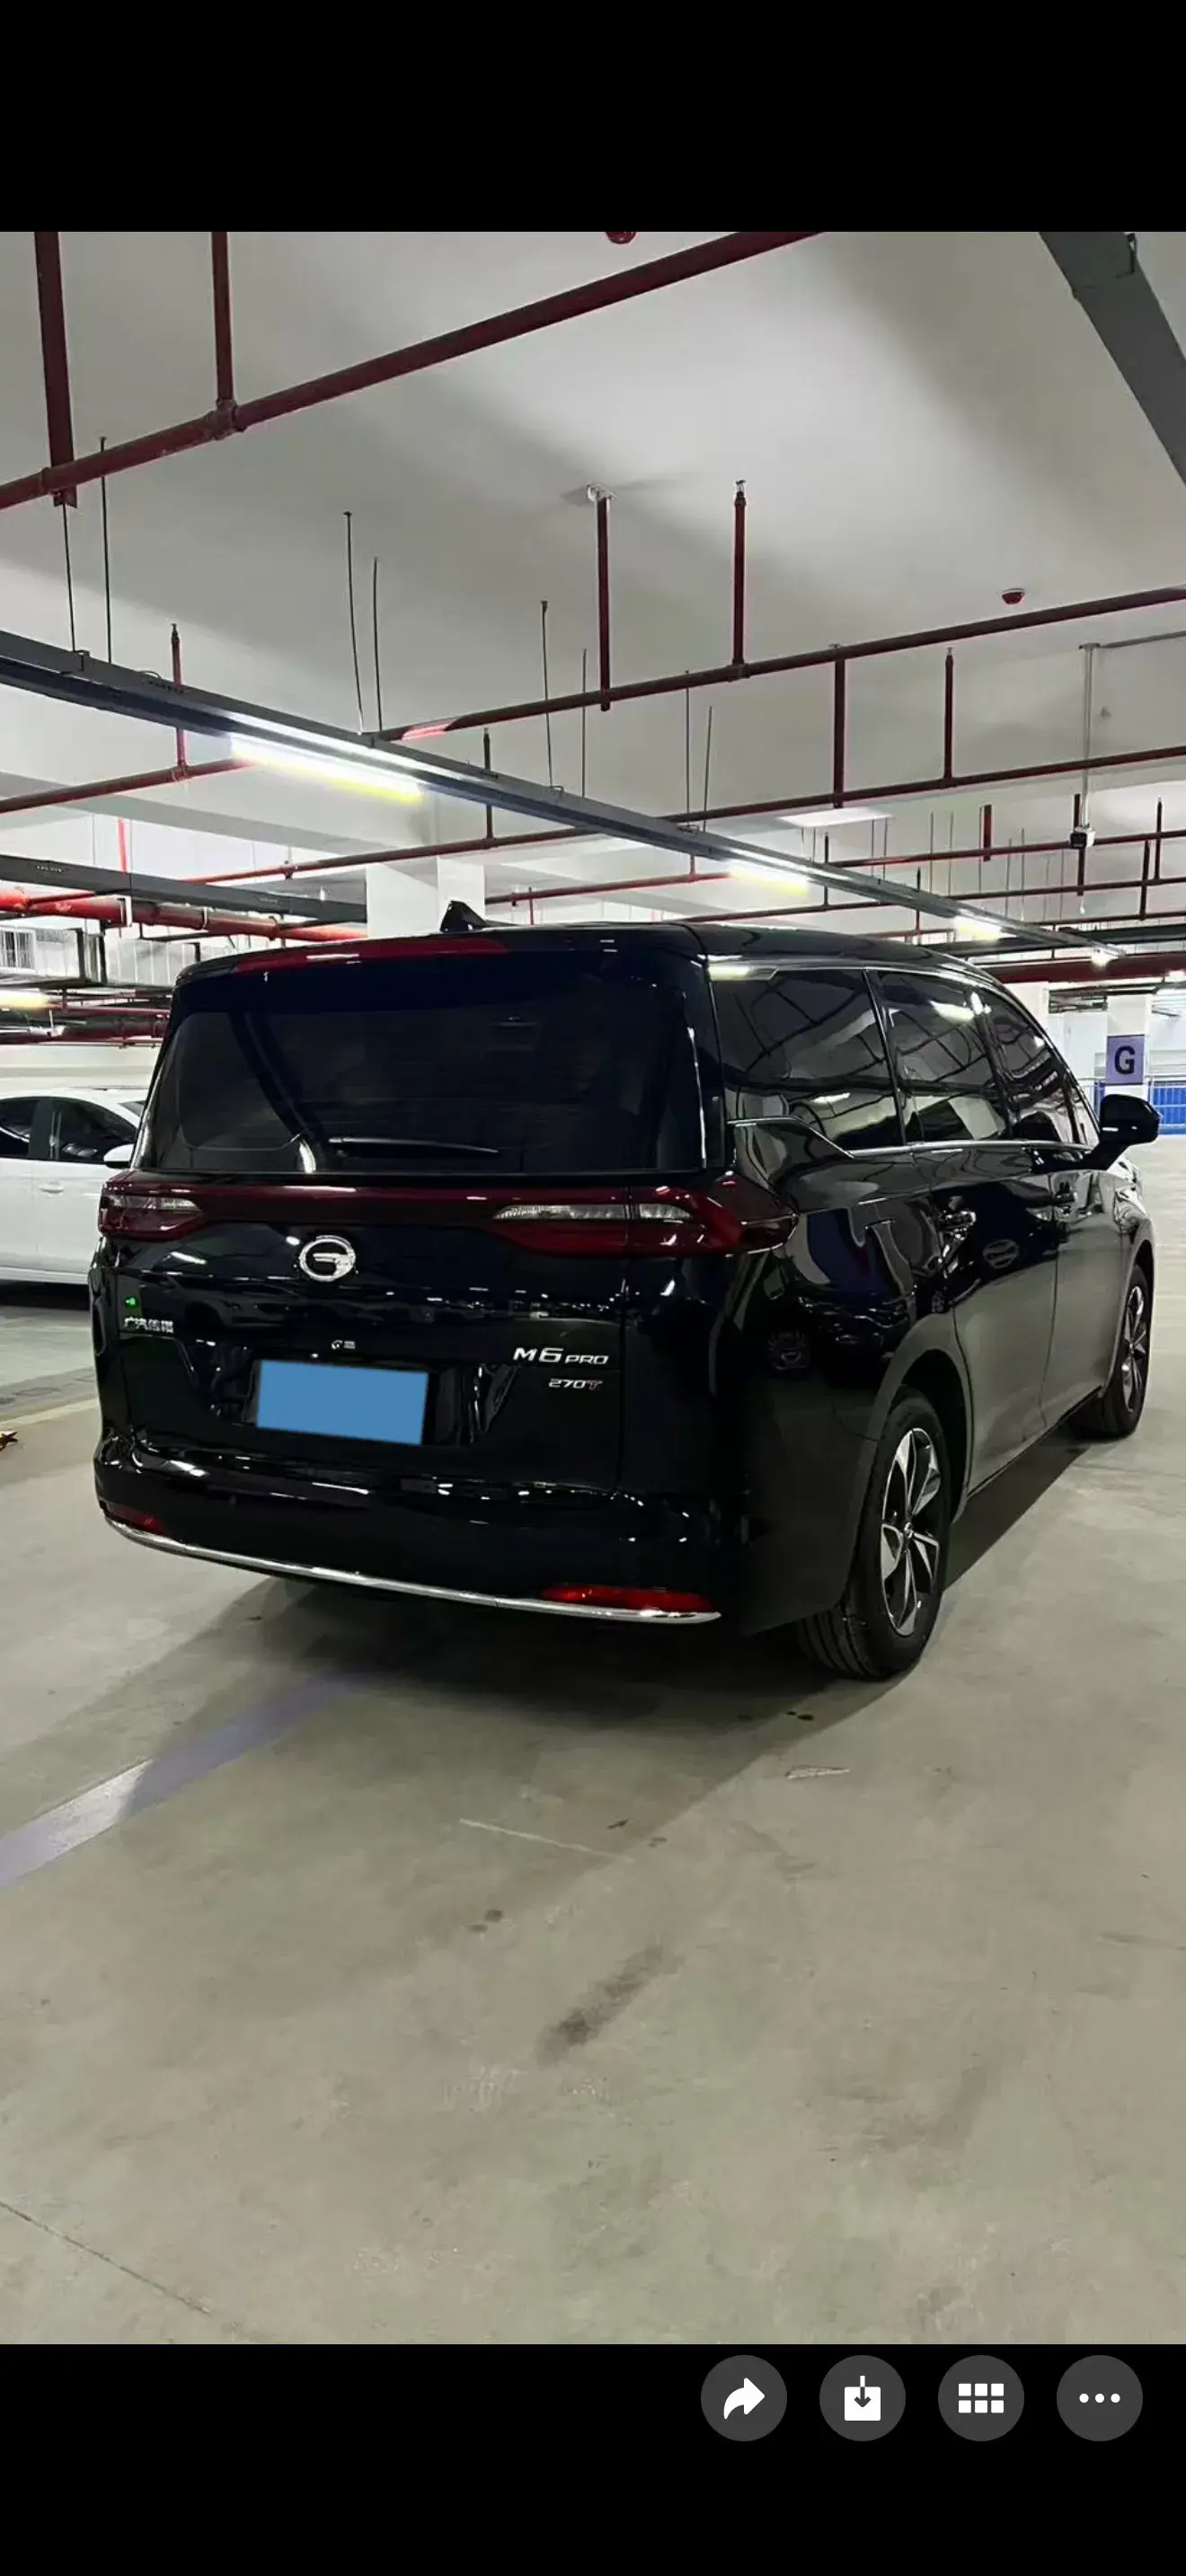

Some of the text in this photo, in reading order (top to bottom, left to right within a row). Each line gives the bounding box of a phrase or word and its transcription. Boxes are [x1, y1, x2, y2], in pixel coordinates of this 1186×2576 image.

[1114, 1045, 1135, 1075] G
[513, 1347, 609, 1364] M6 PRO
[548, 1379, 603, 1390] 270T
